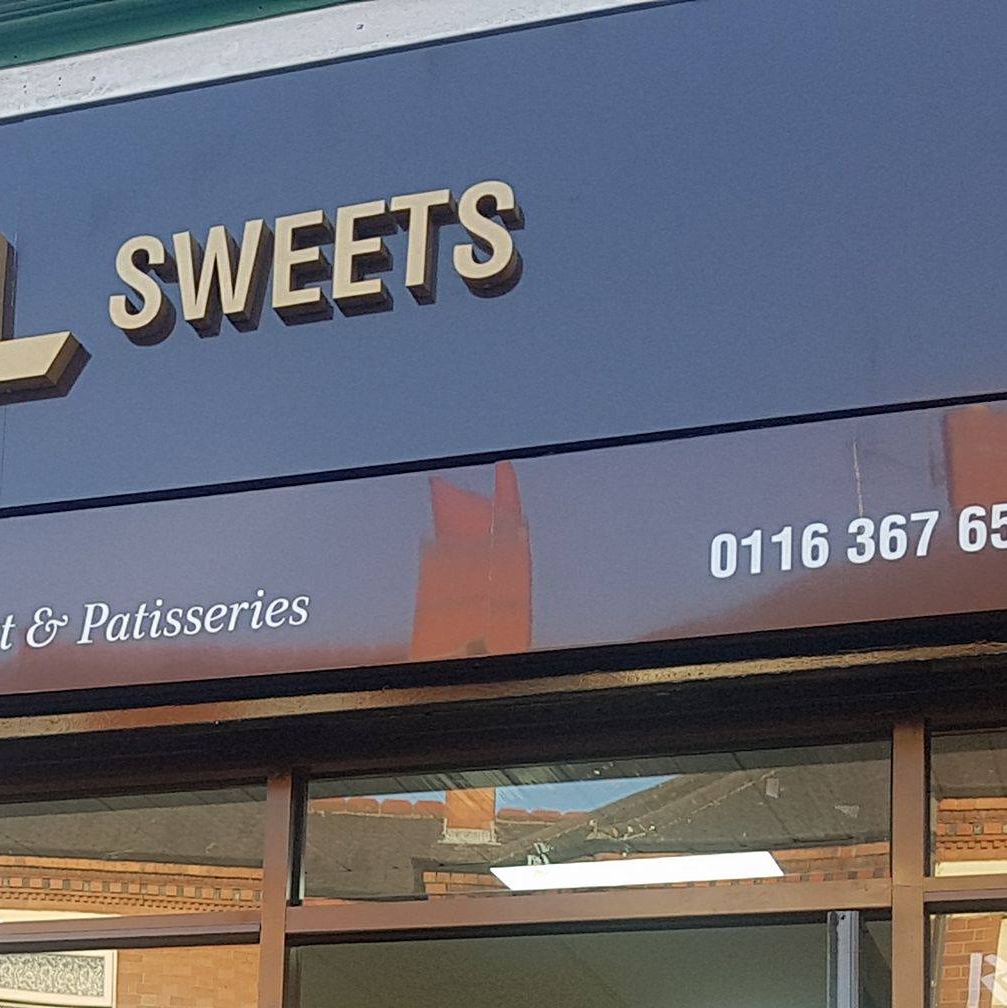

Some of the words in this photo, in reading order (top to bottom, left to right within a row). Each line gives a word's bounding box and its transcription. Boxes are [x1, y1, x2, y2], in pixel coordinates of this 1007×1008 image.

[108, 180, 519, 335] SWEETS
[710, 522, 830, 579] 0116
[846, 510, 940, 564] 367
[25, 606, 70, 648] &
[76, 588, 311, 646] Patisseries
